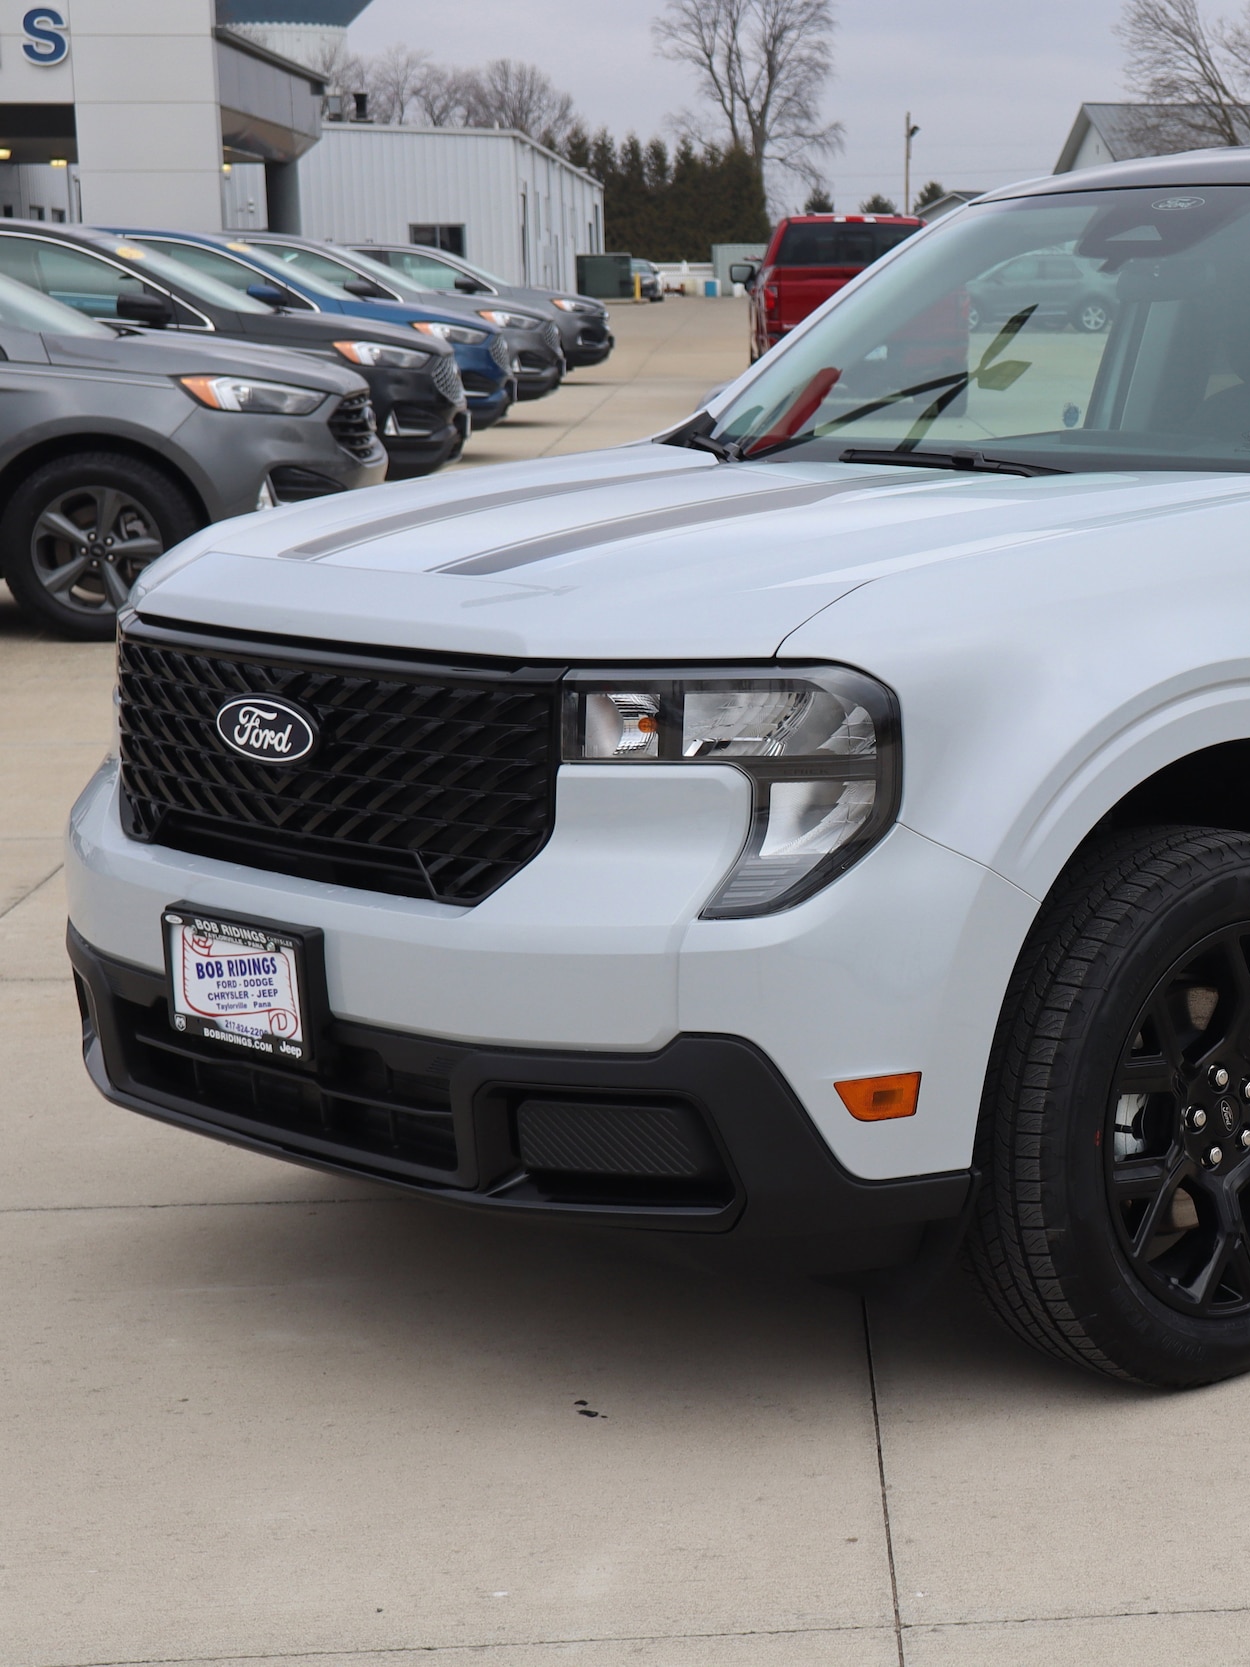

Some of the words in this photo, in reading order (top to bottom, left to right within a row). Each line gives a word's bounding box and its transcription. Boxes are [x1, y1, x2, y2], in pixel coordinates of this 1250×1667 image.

[234, 706, 293, 753] Ford
[194, 918, 219, 933] BOB
[220, 924, 267, 944] RIDINGS
[203, 931, 243, 946] TAYLORVILLE
[247, 941, 265, 950] PANA
[195, 961, 224, 980] BOB
[227, 956, 277, 977] RIDINGS
[216, 980, 237, 989] FORD
[243, 977, 274, 988] DODGE
[207, 990, 249, 1001] CHRYSLER
[256, 988, 278, 998] JEEP
[216, 1002, 247, 1011] Taylorville
[253, 1001, 271, 1009] Pana
[203, 1027, 273, 1053] BOBRIDINGS.COM
[279, 1041, 302, 1059] Jeep
